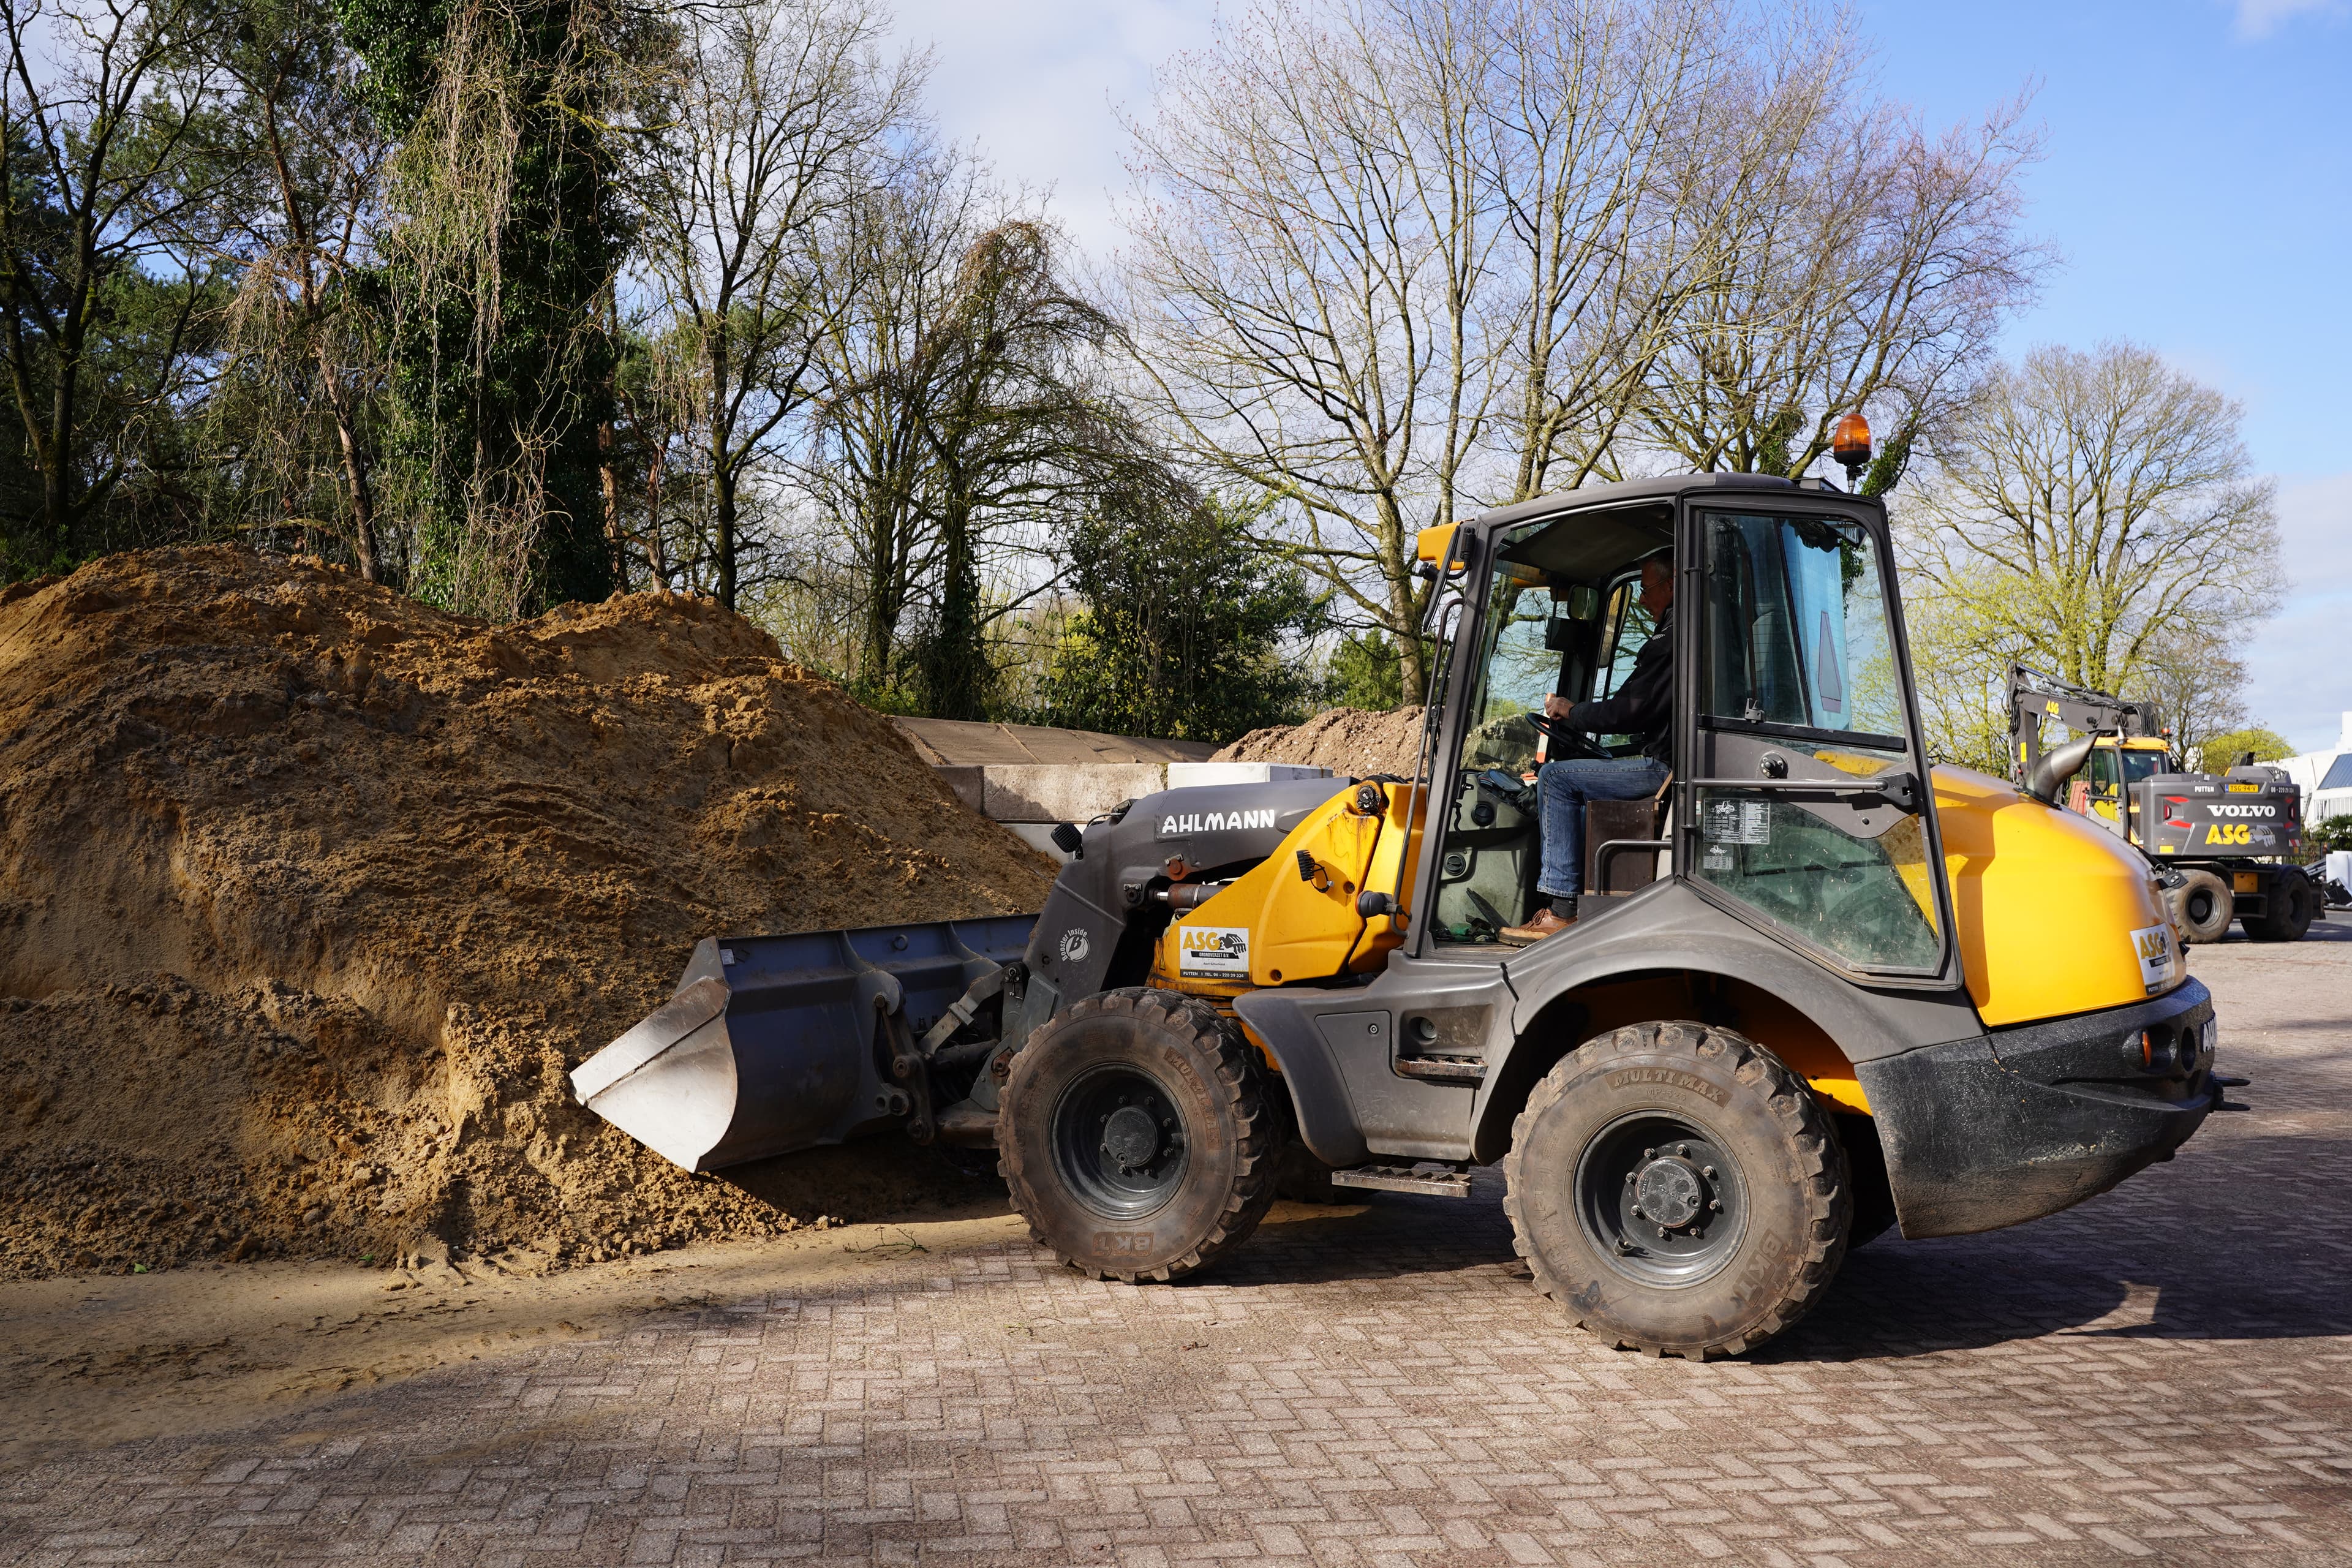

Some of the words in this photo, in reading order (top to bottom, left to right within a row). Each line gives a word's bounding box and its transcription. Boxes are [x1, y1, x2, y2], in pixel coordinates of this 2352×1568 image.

[2045, 699, 2059, 715] ASG
[2207, 805, 2276, 817] VOLVO
[1162, 809, 1275, 834] AHLMANN
[2205, 824, 2250, 845] ASG
[1068, 927, 1088, 937] Inside
[1182, 931, 1221, 951] ASG
[2139, 932, 2164, 960] ASG
[1614, 1069, 1677, 1087] MULTI
[1679, 1073, 1725, 1102] MAX
[1094, 1235, 1152, 1253] BKT
[1739, 1232, 1784, 1302] BKT
